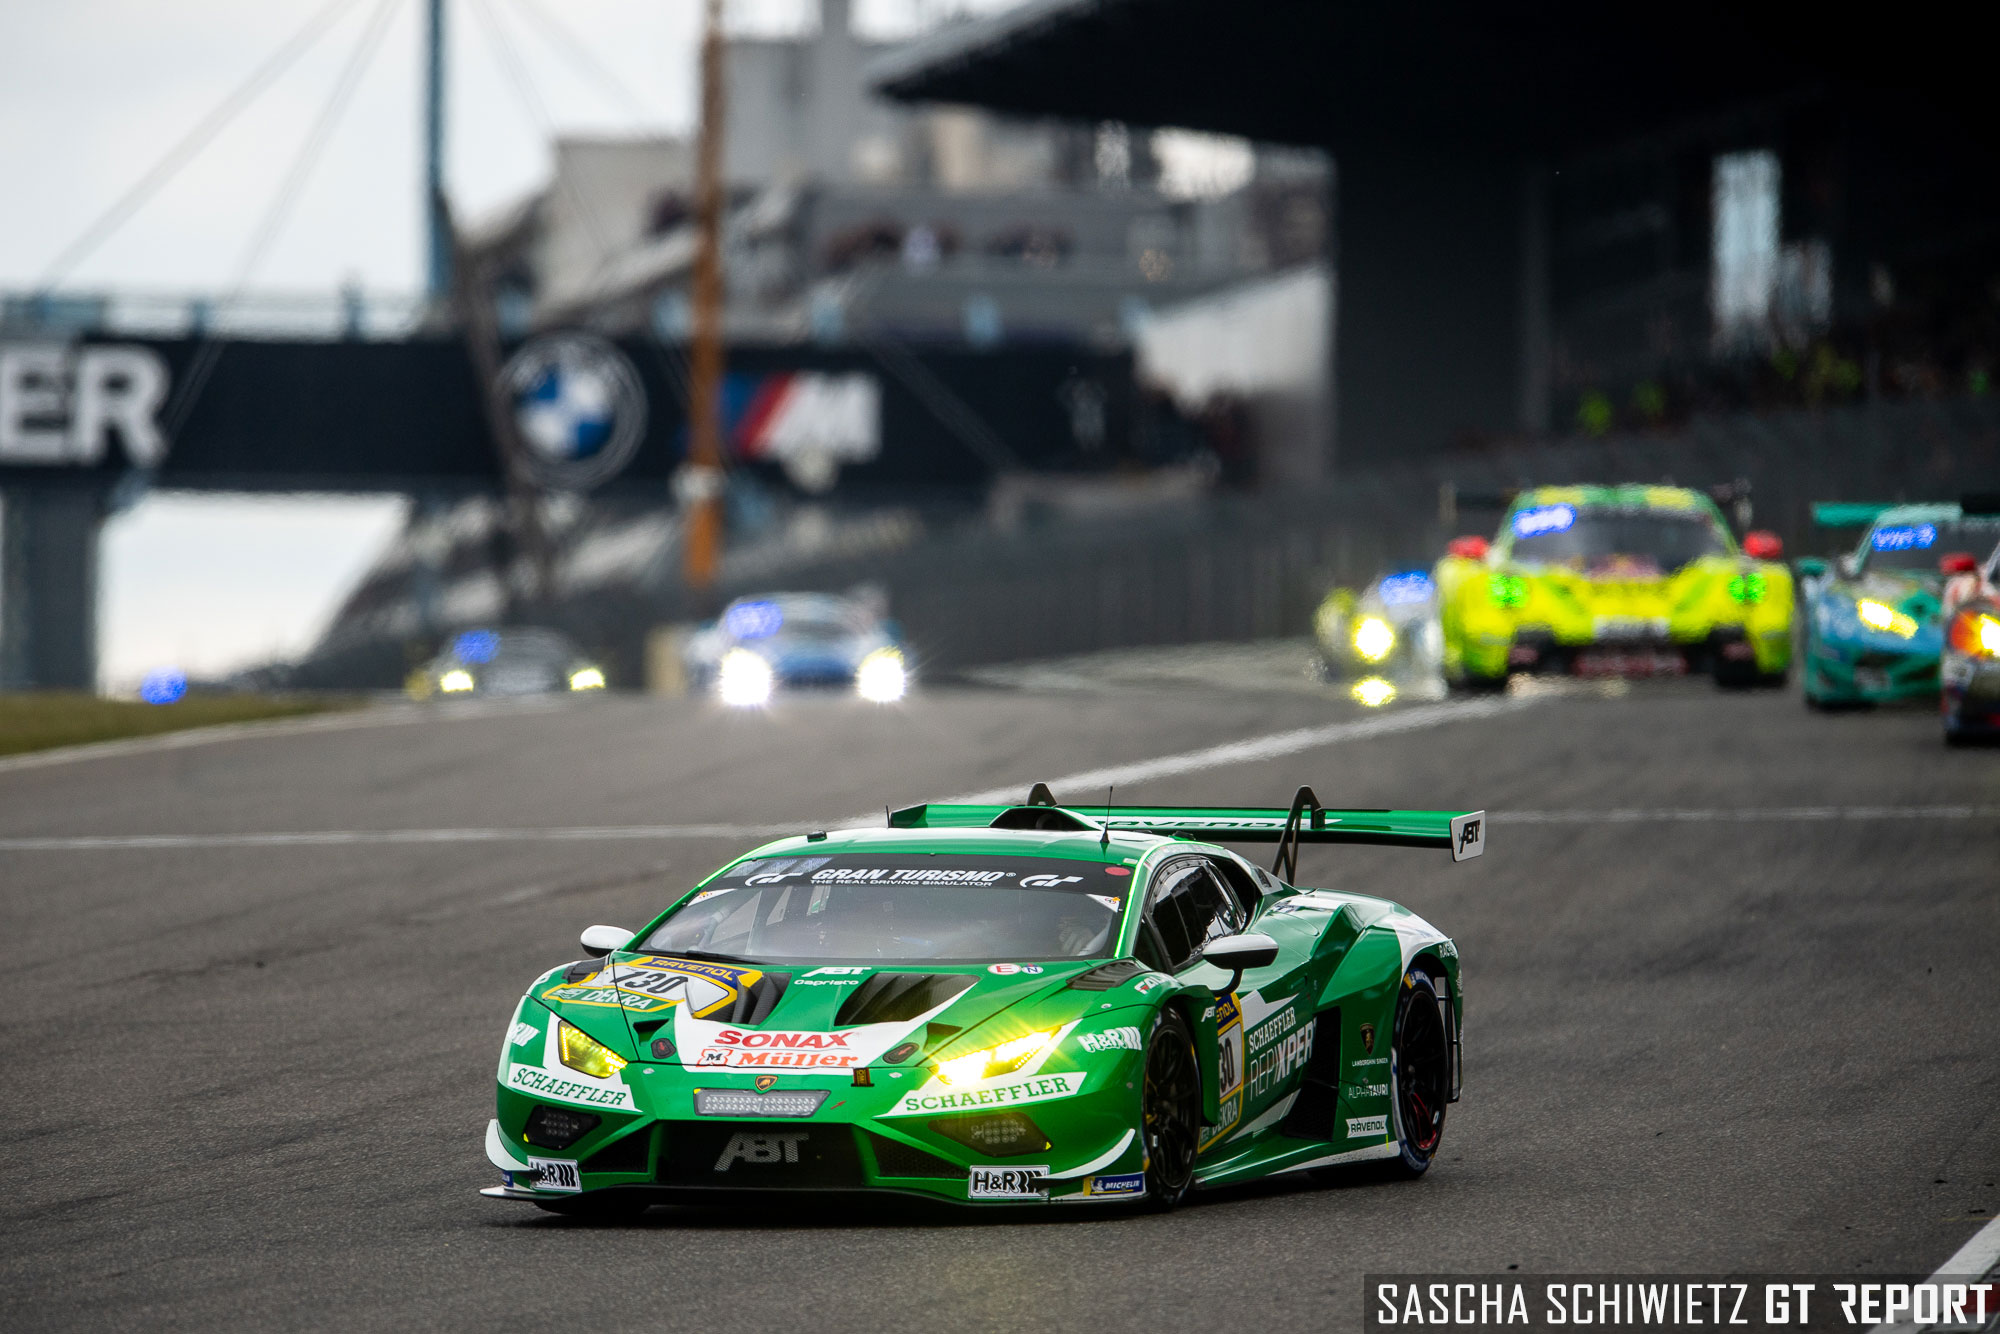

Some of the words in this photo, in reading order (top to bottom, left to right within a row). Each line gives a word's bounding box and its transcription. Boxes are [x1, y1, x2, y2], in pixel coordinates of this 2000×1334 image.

[1459, 820, 1480, 854] ABT
[811, 869, 888, 880] GRAN
[651, 959, 734, 981] RAVENOL
[801, 966, 872, 978] ABT
[609, 971, 689, 994] 130
[793, 979, 860, 987] Capristo
[580, 987, 654, 1010] DEKRA
[1201, 1005, 1216, 1023] ABT
[714, 1030, 854, 1049] SONAX
[1249, 1006, 1297, 1055] SCHAEFFLER
[1077, 1031, 1126, 1053] H&R
[735, 1052, 859, 1067] Müller
[513, 1067, 627, 1106] SCHAEFFLER
[905, 1077, 1071, 1111] SCHAEFFLER
[1348, 1084, 1389, 1099] ALPHATAURI
[1350, 1120, 1385, 1133] RAVENOL
[713, 1132, 810, 1172] ABT
[1104, 1179, 1140, 1190] MICHELIN
